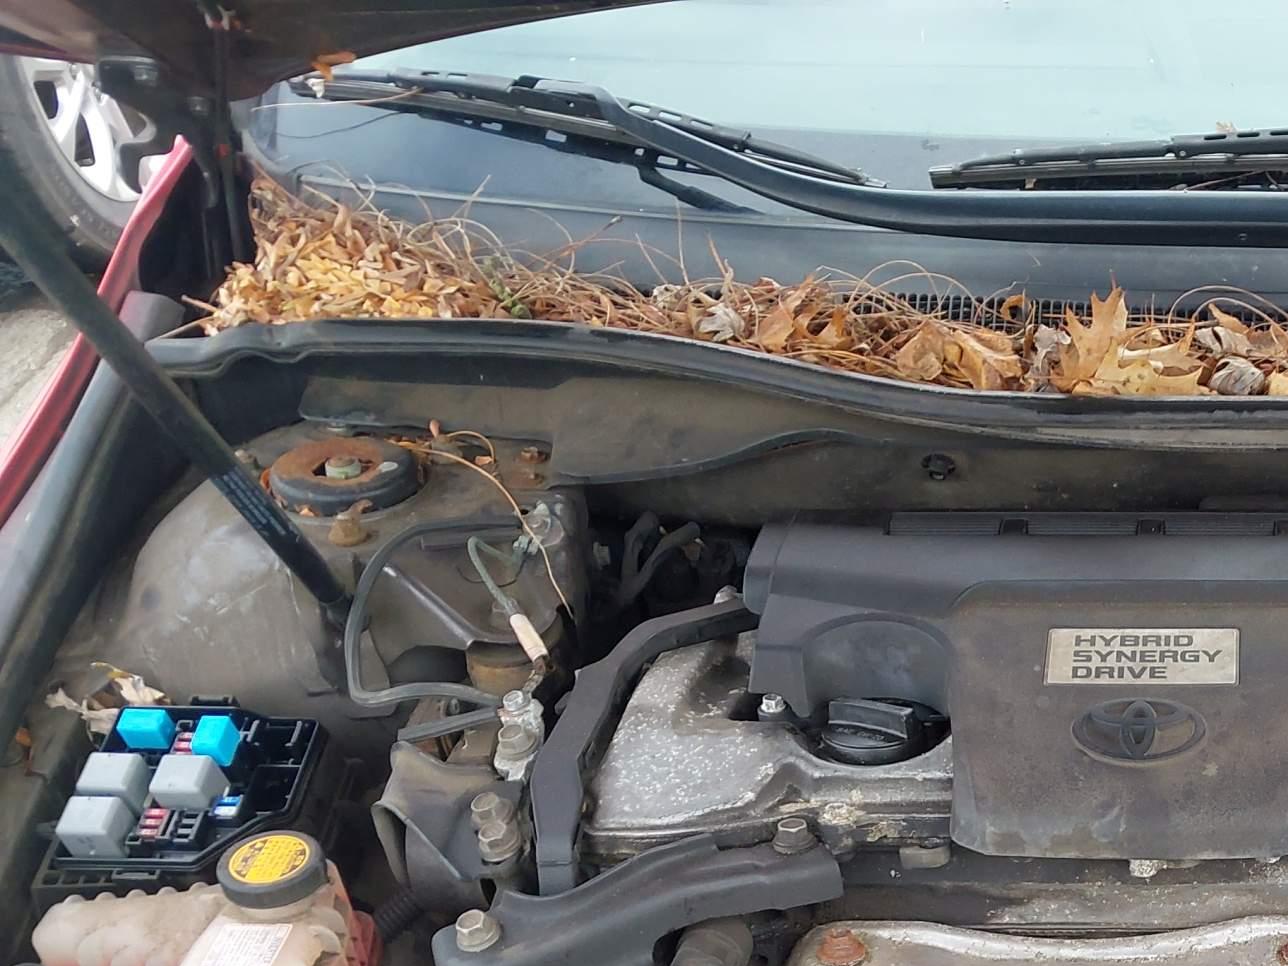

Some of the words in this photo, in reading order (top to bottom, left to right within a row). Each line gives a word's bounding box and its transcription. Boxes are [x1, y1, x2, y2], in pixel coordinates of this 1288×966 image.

[1074, 634, 1193, 647] HYBRID
[1072, 649, 1222, 663] SYNERGY
[1071, 666, 1167, 679] DRIVE
